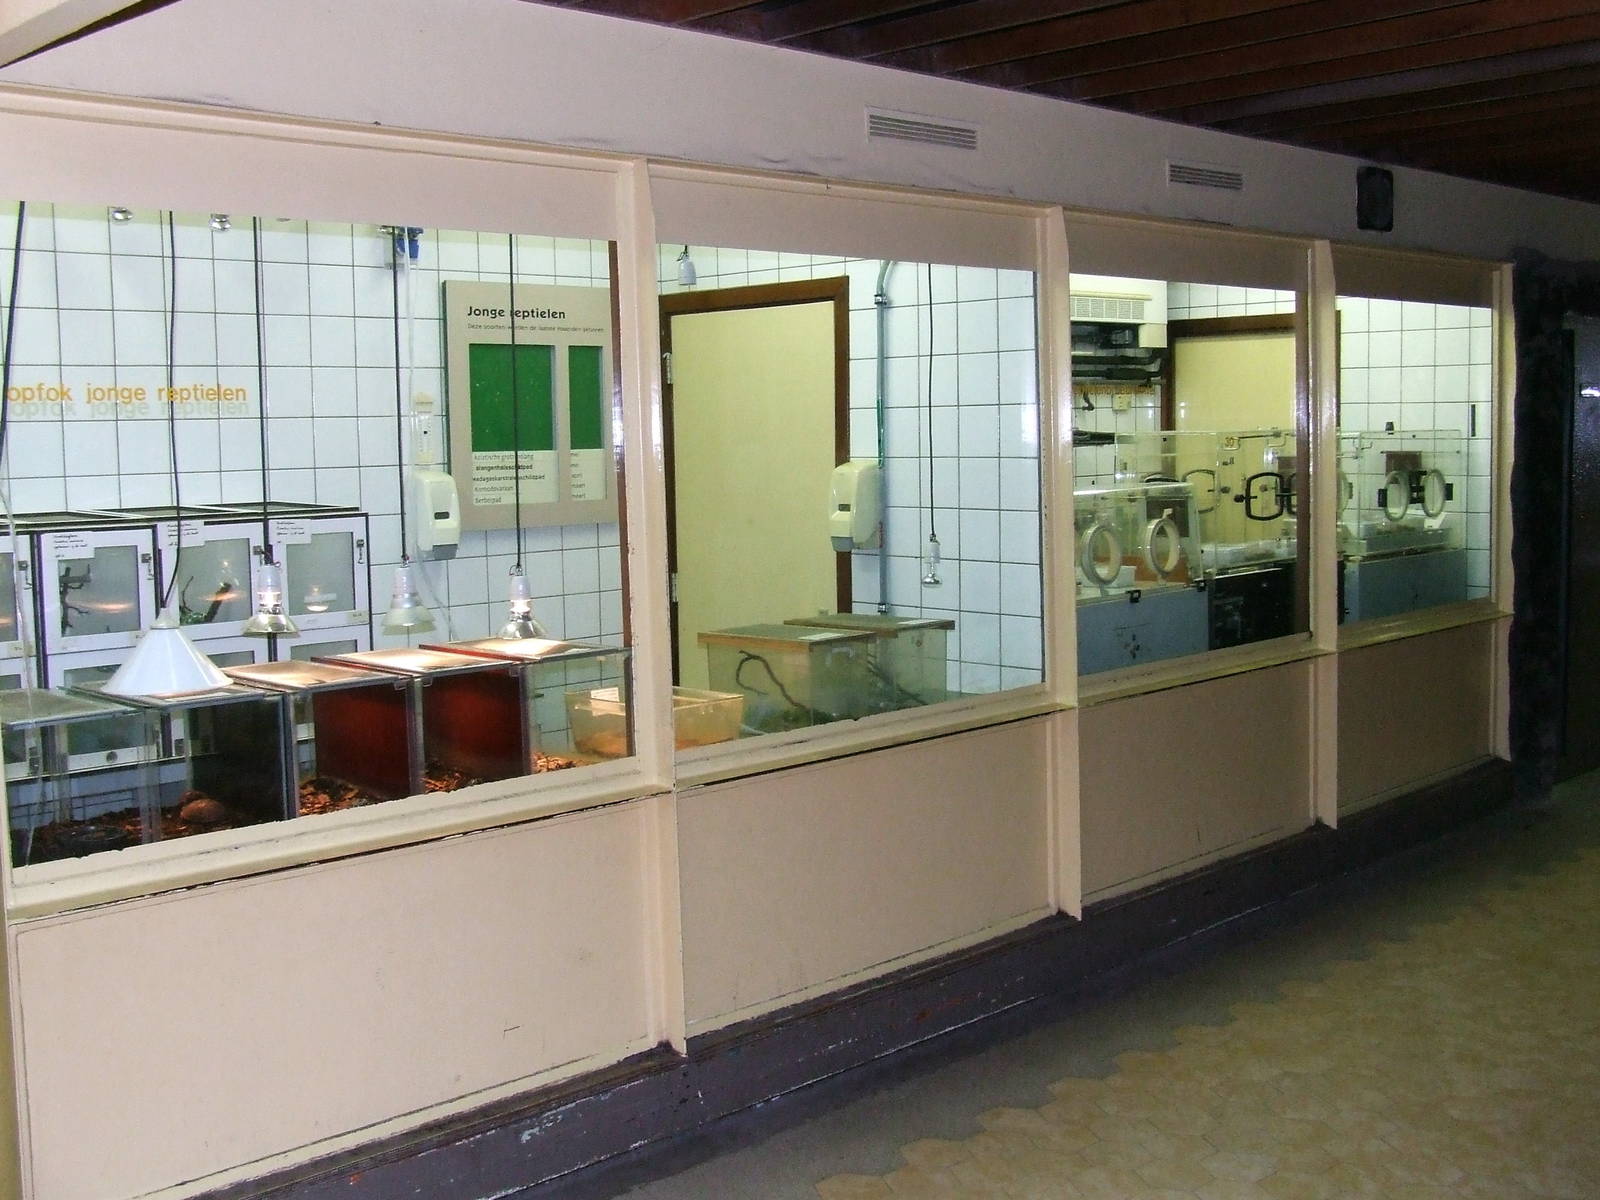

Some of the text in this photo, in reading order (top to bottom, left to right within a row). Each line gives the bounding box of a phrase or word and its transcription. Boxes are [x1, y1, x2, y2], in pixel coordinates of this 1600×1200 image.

[467, 306, 505, 319] Jonge
[7, 383, 247, 405] opfok jonge reptielen
